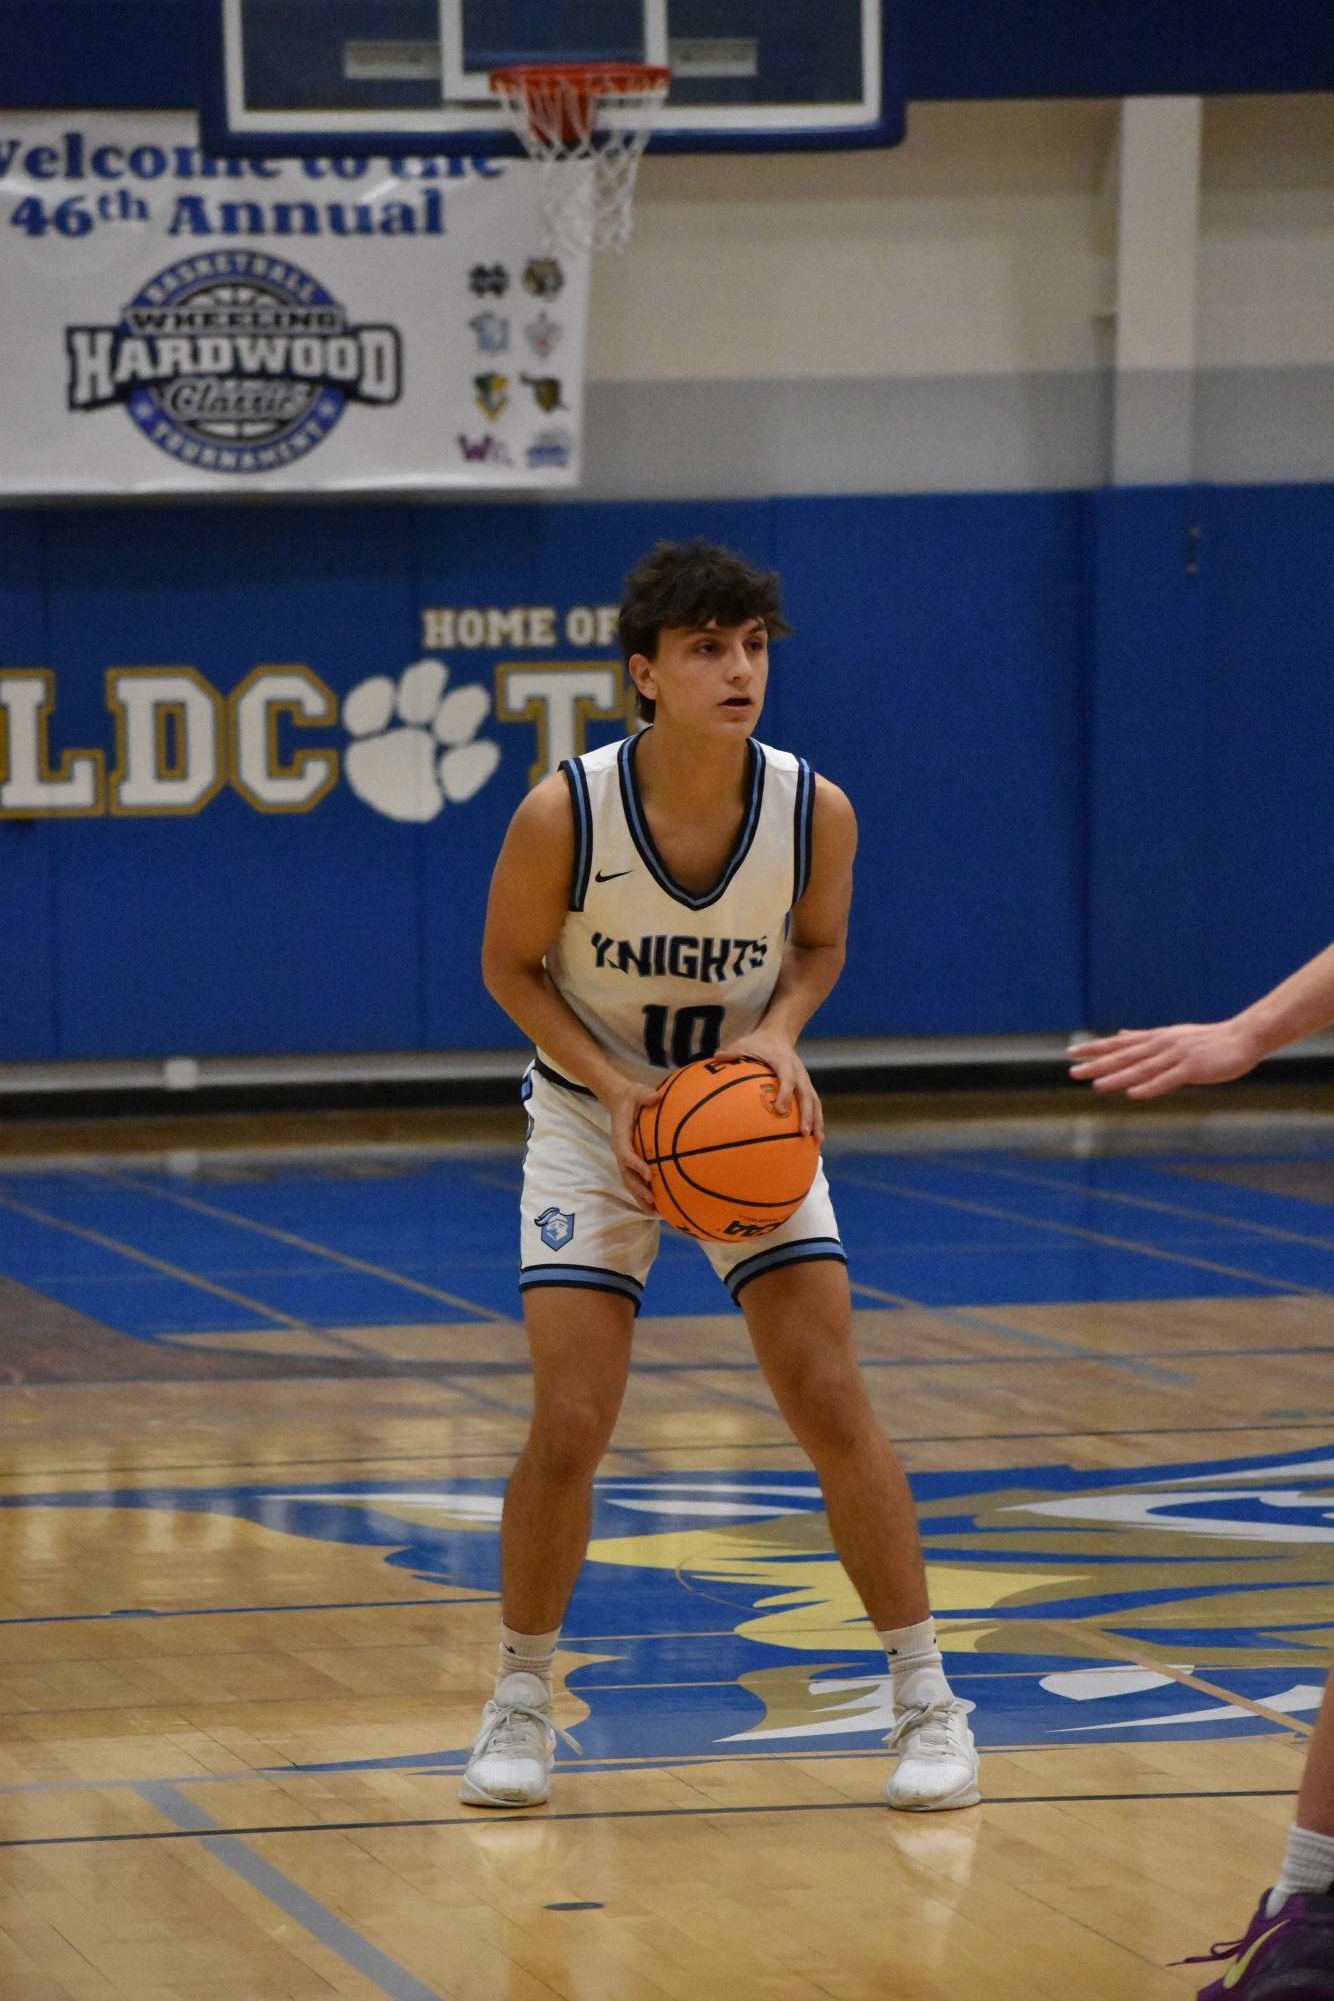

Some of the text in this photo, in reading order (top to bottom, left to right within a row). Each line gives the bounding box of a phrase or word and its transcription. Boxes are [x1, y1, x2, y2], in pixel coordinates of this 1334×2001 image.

[10, 187, 446, 237] 46th Annual
[131, 311, 339, 331] WHEELING
[70, 331, 397, 404] HARDWOOD
[423, 605, 624, 649] HOME OF
[590, 931, 769, 984] KNIGHTS
[641, 1003, 726, 1069] 10
